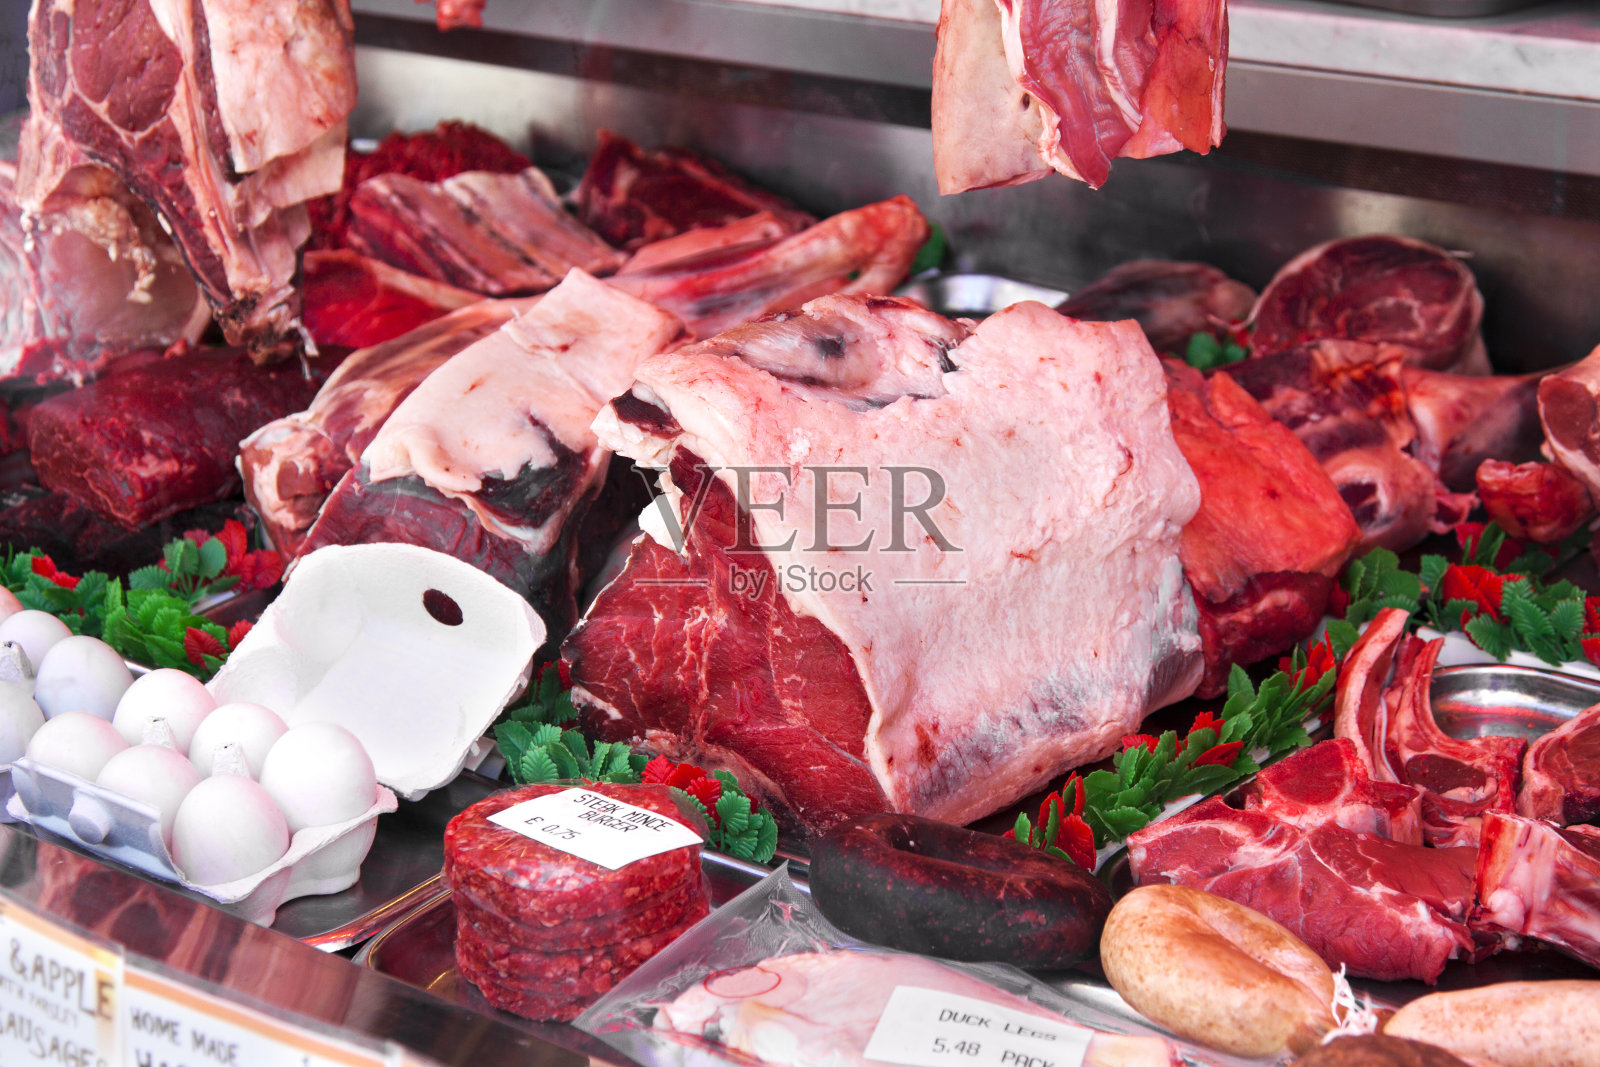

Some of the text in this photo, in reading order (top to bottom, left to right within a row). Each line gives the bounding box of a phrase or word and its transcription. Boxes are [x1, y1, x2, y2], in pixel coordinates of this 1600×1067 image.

[573, 793, 674, 832] STEAK MINCE
[577, 810, 639, 833] BURGER
[541, 824, 582, 841] 0.75
[0, 1011, 107, 1067] AUSAGE
[130, 1006, 181, 1046] HOME
[191, 1029, 239, 1067] MADE
[938, 1008, 1058, 1042] DUCK LEGS
[932, 1037, 981, 1057] 5.48
